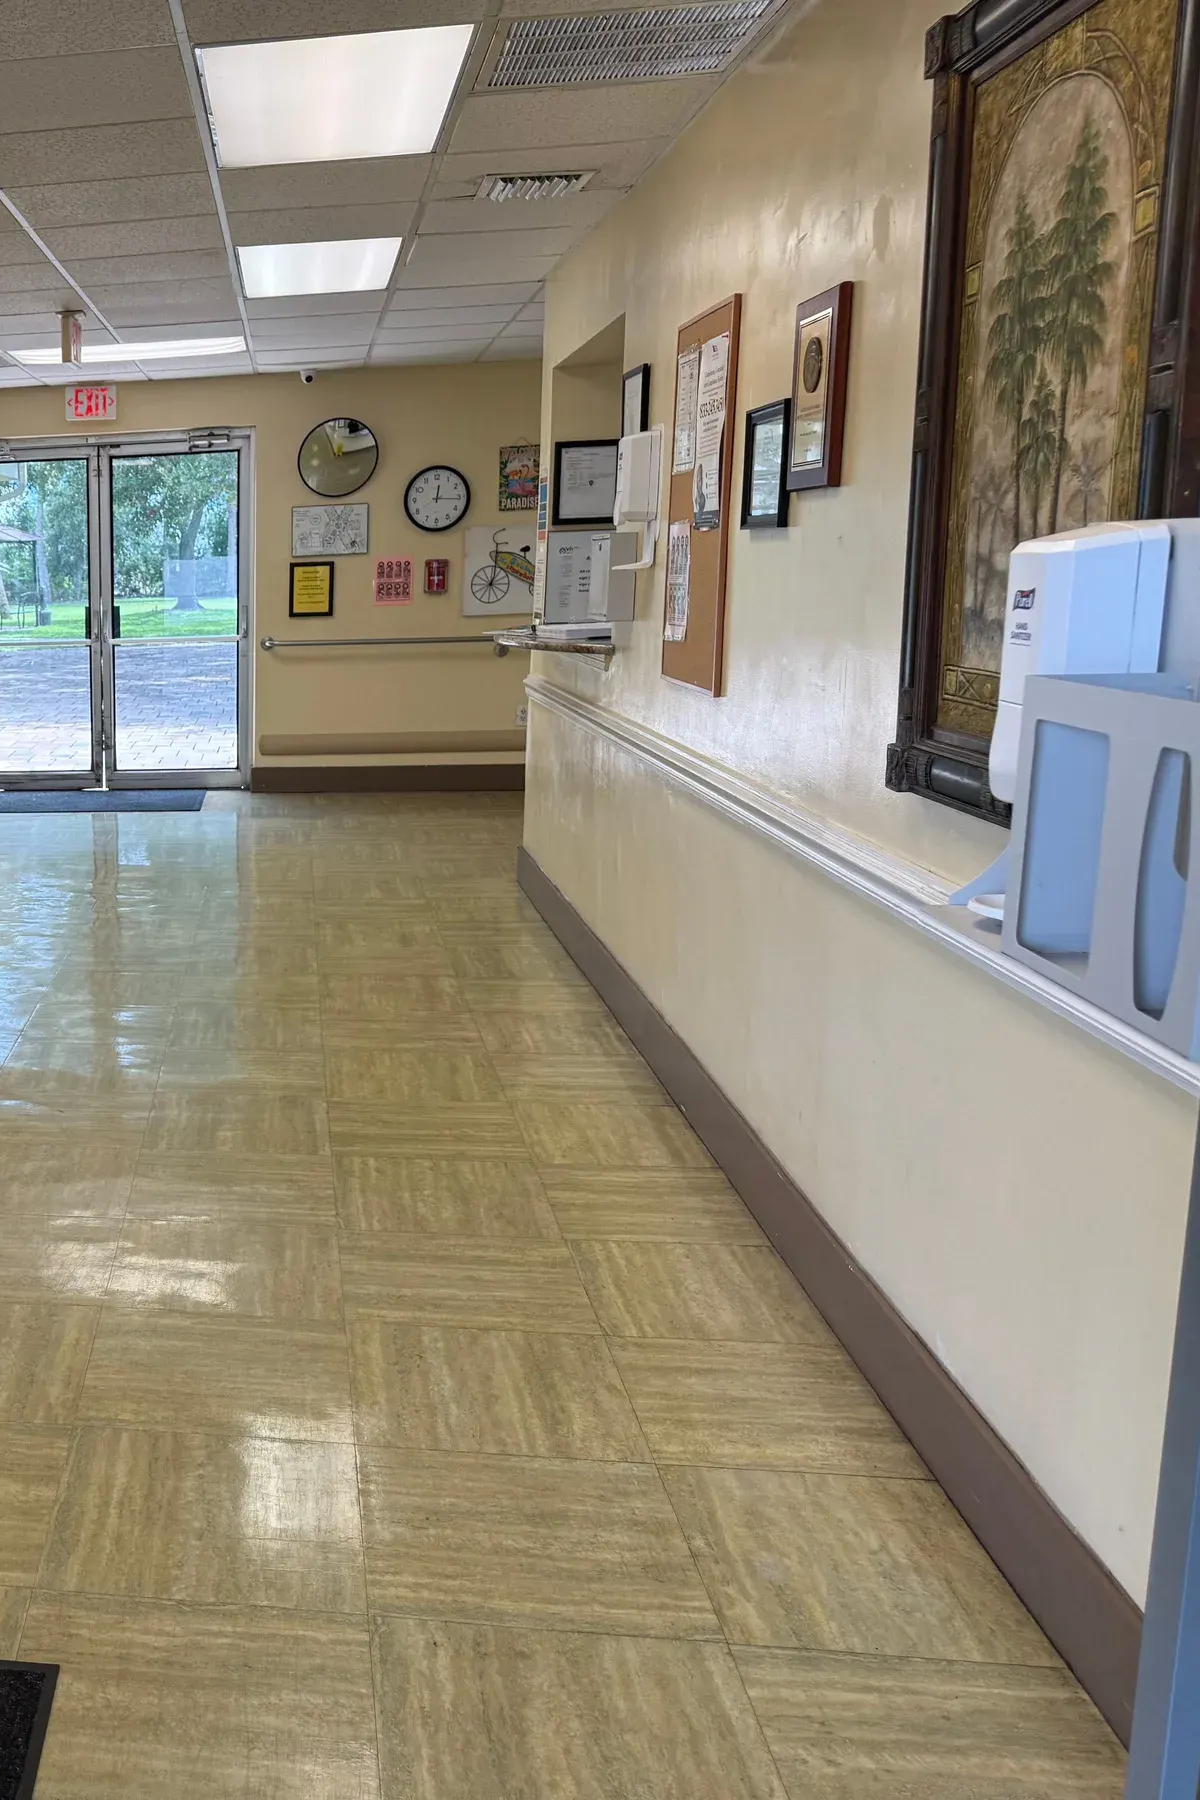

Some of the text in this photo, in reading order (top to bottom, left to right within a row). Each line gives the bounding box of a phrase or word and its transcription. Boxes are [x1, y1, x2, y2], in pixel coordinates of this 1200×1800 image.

[74, 386, 109, 418] EXIT
[502, 497, 539, 510] PARADISE
[1015, 622, 1029, 630] HAND
[1010, 631, 1031, 641] SANITIZER
